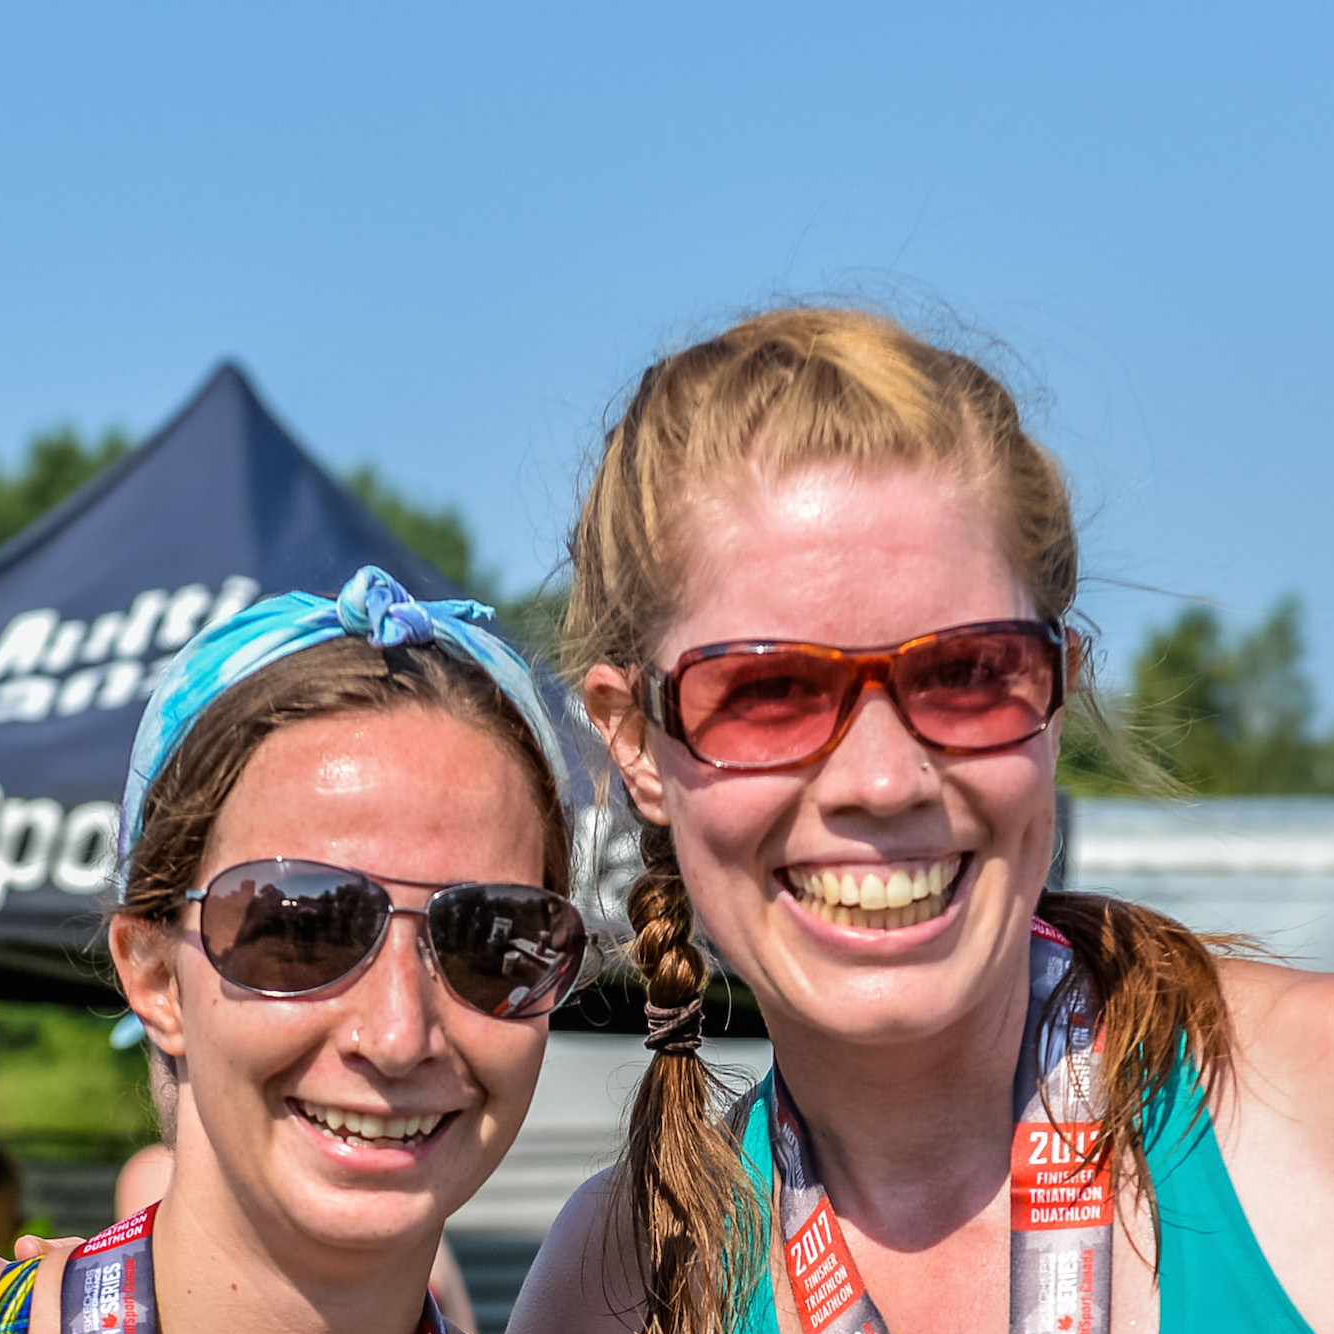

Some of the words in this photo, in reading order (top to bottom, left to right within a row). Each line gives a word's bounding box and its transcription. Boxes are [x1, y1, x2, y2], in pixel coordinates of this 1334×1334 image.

[1031, 1205, 1101, 1223] DUATHLON
[83, 1224, 144, 1254] DUATHLON
[790, 1210, 832, 1277] 2017
[100, 1262, 122, 1312] SERIES
[804, 1252, 838, 1292] FINISHER
[805, 1265, 848, 1312] TRIATHLON
[1057, 1250, 1079, 1314] SERIES
[810, 1282, 854, 1328] DUATHLON
